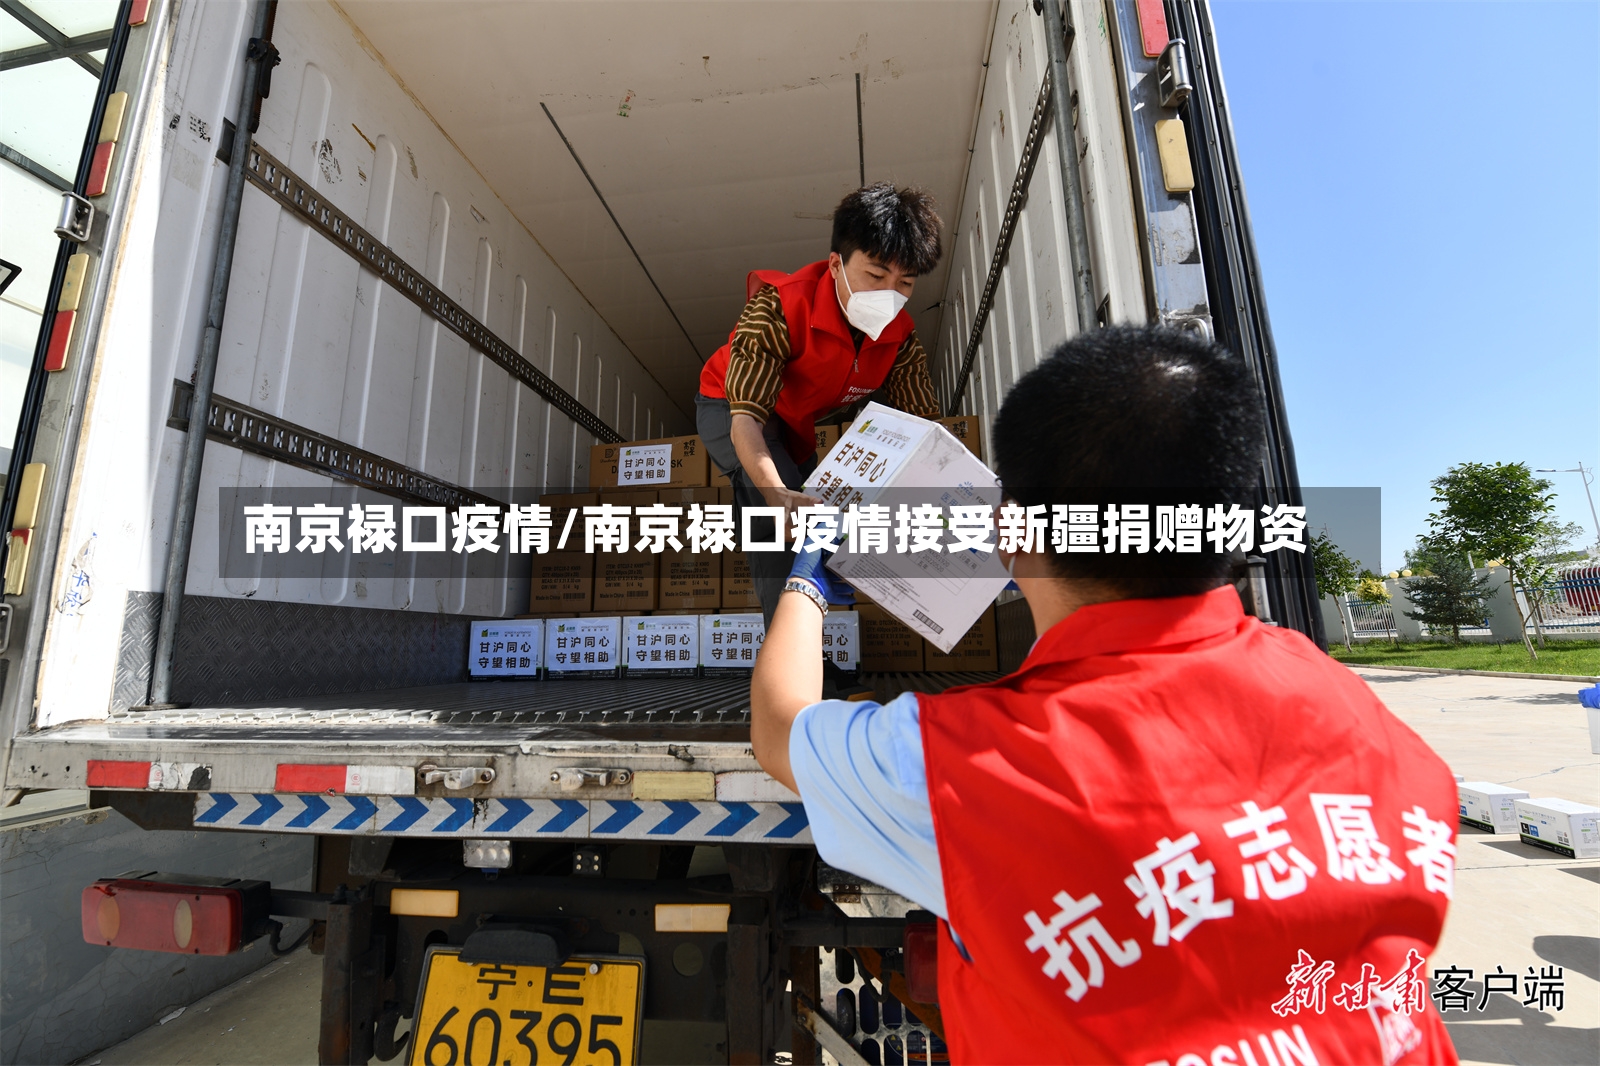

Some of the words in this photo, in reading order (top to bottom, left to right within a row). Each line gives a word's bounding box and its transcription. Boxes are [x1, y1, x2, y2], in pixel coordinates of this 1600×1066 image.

[624, 457, 666, 468] 甘沪同心
[834, 441, 888, 483] 甘沪同心
[624, 469, 666, 480] 守望相助
[816, 470, 864, 513] 守望相助
[557, 636, 610, 648] 甘沪同心
[637, 634, 690, 646] 甘沪同心
[712, 632, 766, 644] 甘沪同心
[822, 634, 848, 646] 同心
[480, 642, 531, 653] 甘沪同心
[556, 651, 609, 664] 守望相助
[636, 649, 690, 662] 守望相助
[712, 648, 760, 660] 守望相
[478, 657, 530, 668] 守望相助
[1024, 792, 1456, 1002] 抗疫志愿者
[424, 1006, 623, 1066] 60395
